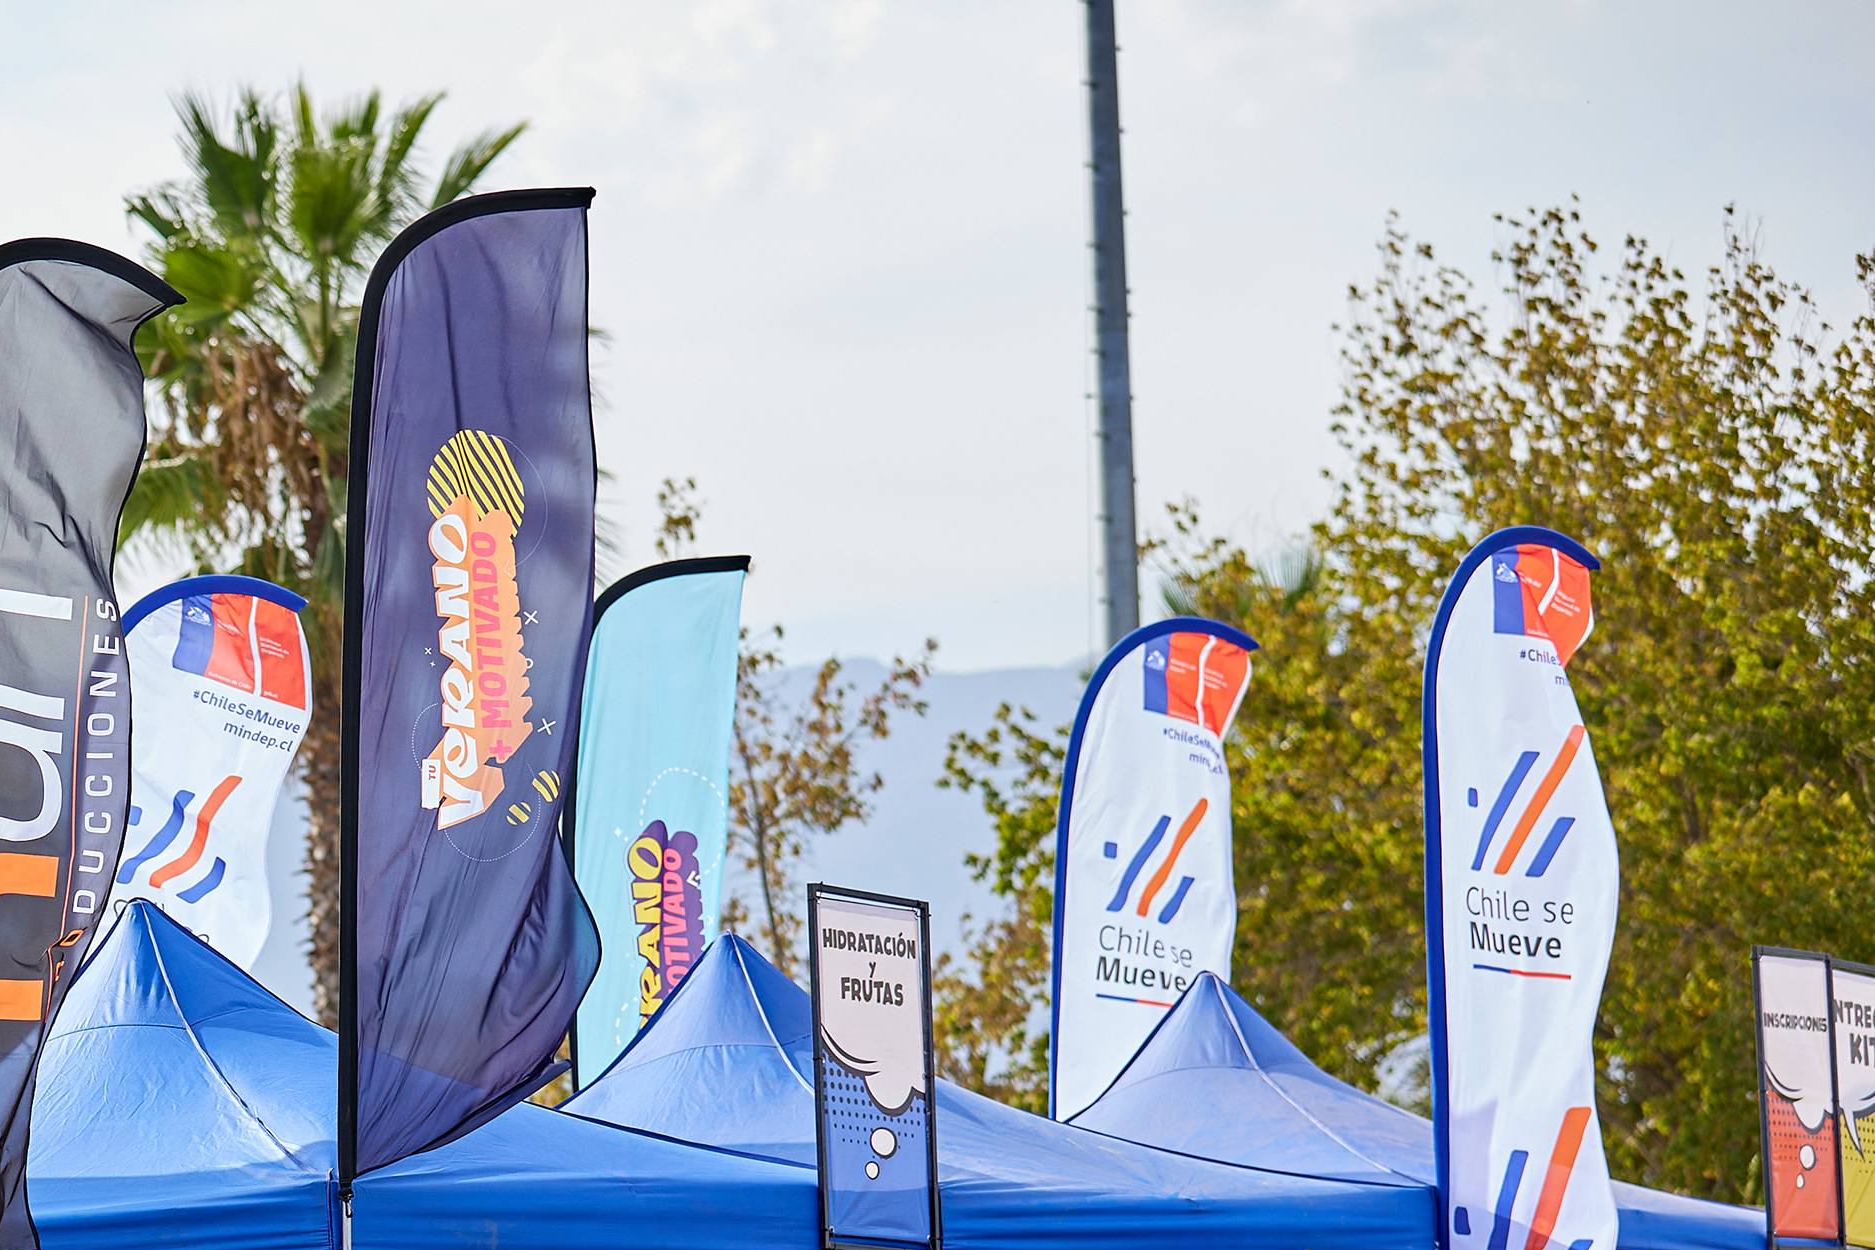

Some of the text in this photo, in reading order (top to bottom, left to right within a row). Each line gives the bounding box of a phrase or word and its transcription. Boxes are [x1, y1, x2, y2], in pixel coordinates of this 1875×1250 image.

[470, 531, 512, 728] MOTIVADO
[193, 690, 301, 734] #ChileSeMueve
[223, 721, 294, 752] mindep.cl
[663, 848, 691, 994] OTIVADO
[1466, 886, 1574, 925] Chile se
[822, 928, 916, 960] HIDRATACIÓN
[1099, 924, 1193, 968] Chile se
[1469, 921, 1562, 959] Mueve
[840, 976, 904, 1007] FRUTAS
[1096, 955, 1188, 993] Mueve
[1763, 1012, 1828, 1033] INSCRIPCIONES
[1831, 998, 1875, 1029] NTRE
